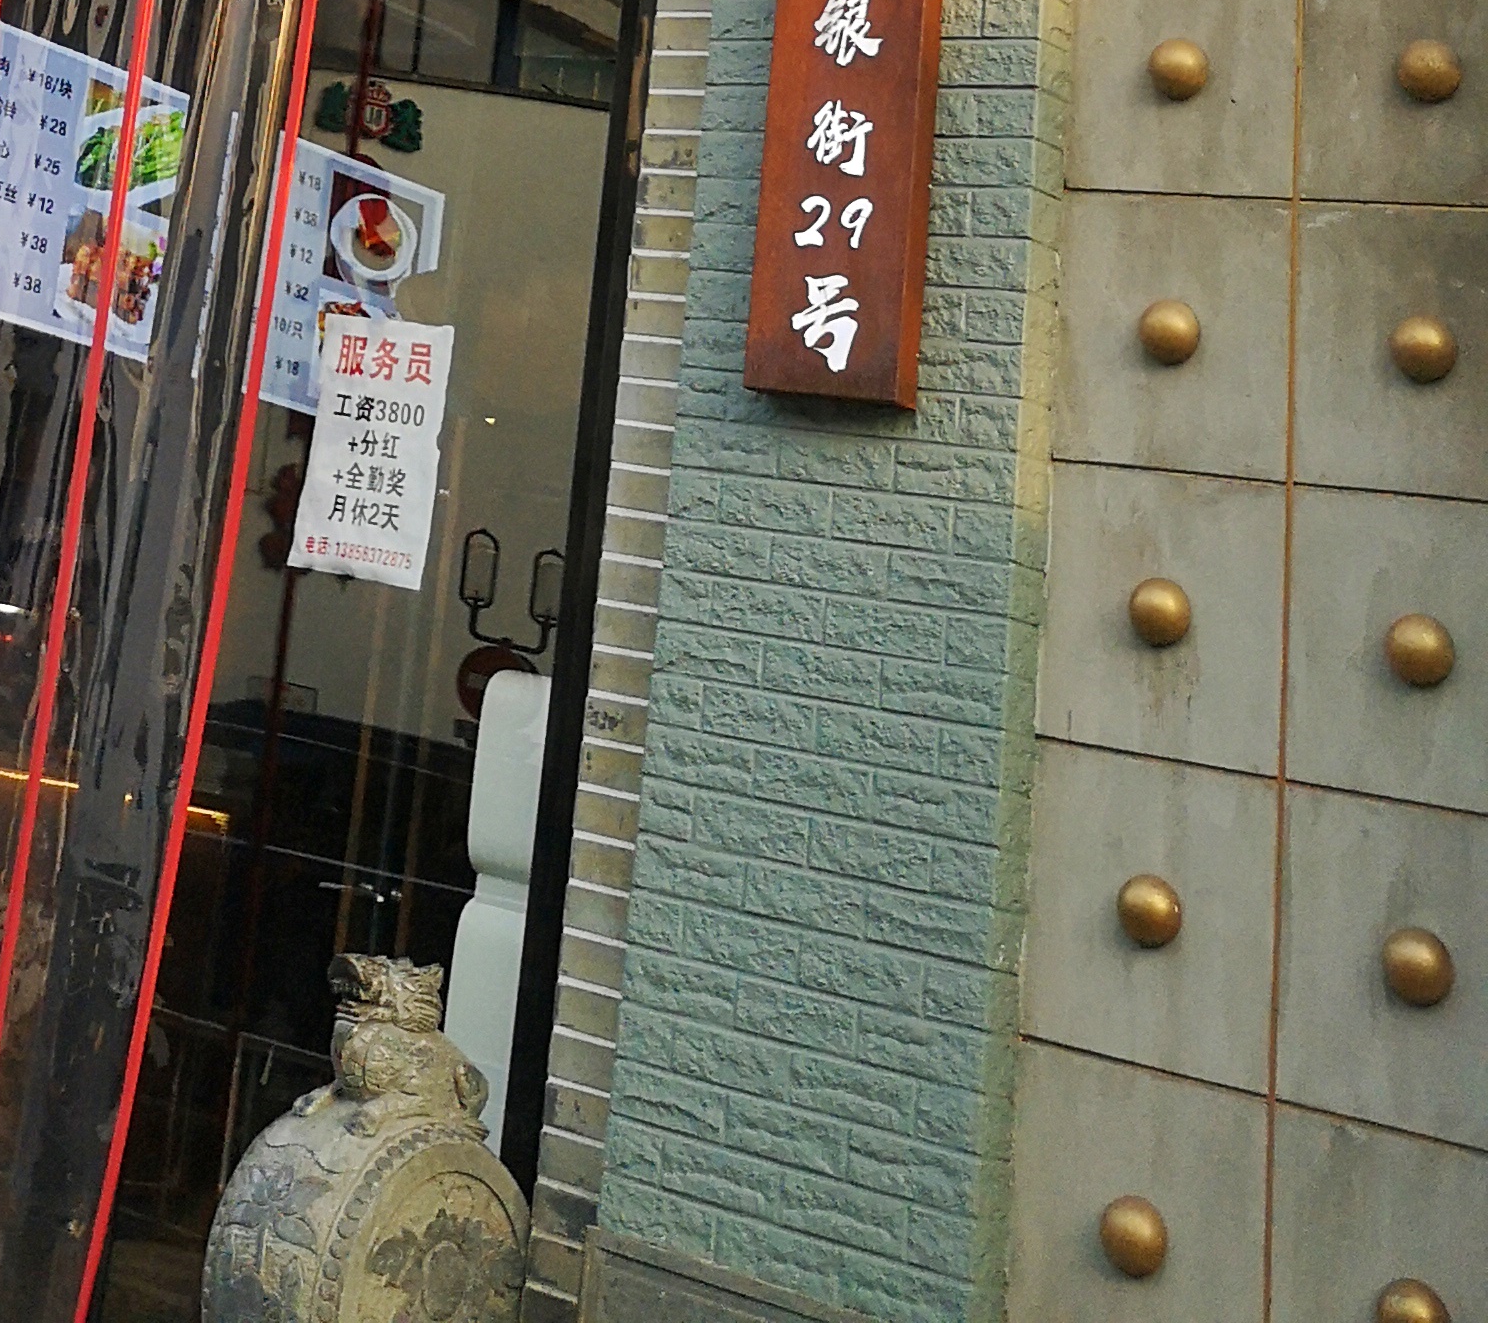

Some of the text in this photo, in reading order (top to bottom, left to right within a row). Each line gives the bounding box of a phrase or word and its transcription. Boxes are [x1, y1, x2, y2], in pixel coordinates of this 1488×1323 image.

[39, 114, 67, 136] ¥28
[27, 193, 54, 215] ¥12
[20, 231, 48, 254] ¥38
[13, 272, 42, 294] ¥38
[336, 334, 431, 385] 服务员
[333, 393, 425, 426] 工资3800
[348, 430, 400, 459] +分红
[333, 462, 406, 497] +全勤奖
[328, 494, 399, 531] 月休2天
